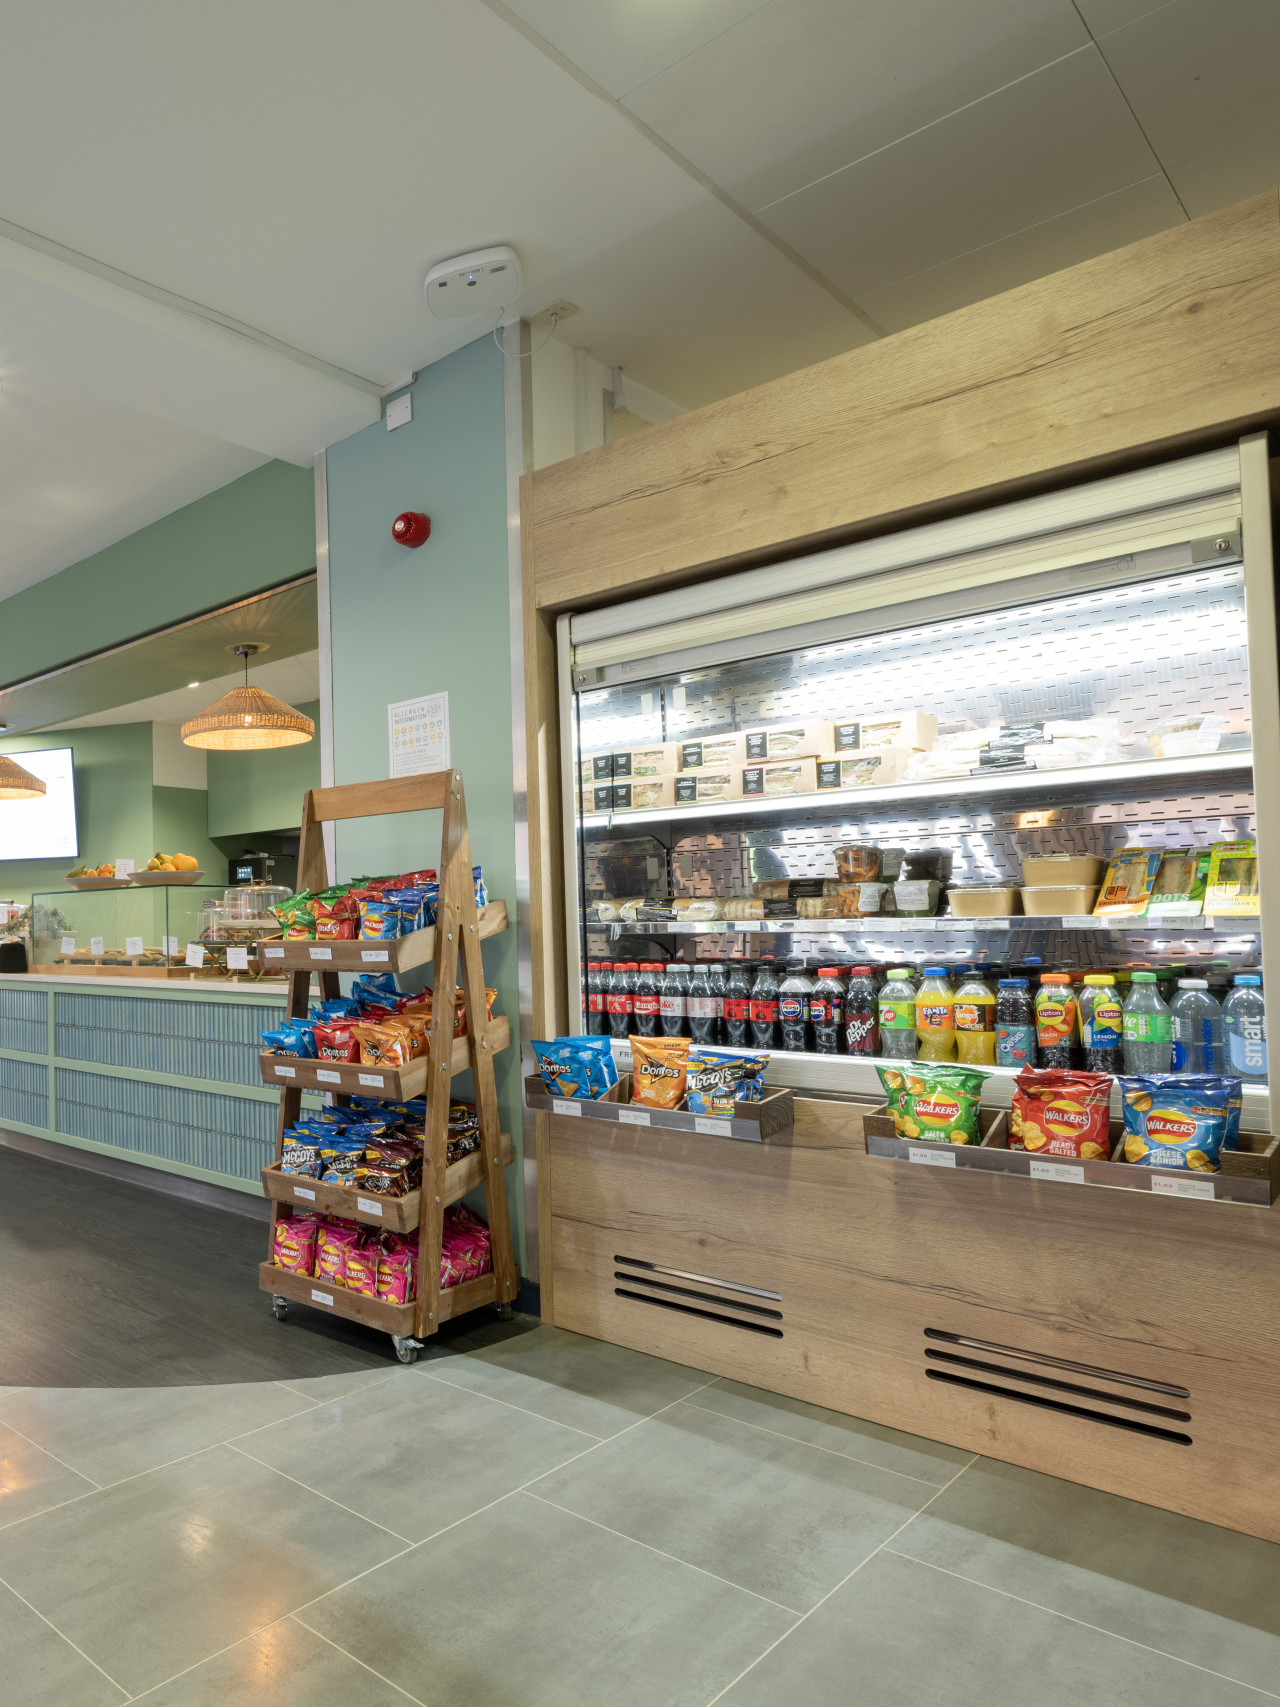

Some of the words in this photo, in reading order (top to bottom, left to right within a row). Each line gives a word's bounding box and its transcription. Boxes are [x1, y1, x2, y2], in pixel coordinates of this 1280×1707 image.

[923, 1007, 948, 1016] FANTA
[846, 1016, 876, 1046] Pepper
[850, 1018, 862, 1033] Dr
[1000, 1031, 1025, 1053] Oasis
[1242, 1015, 1263, 1067] smart
[322, 1047, 349, 1057] Doritos
[539, 1062, 572, 1073] Doritos
[641, 1064, 680, 1078] Doritos
[916, 1101, 959, 1115] WALKERS
[1045, 1109, 1090, 1127] WALKERS
[1146, 1118, 1195, 1134] WALKERS
[1051, 1140, 1076, 1149] READY
[1049, 1147, 1077, 1157] SALTED
[1151, 1150, 1182, 1158] CHEESE
[1157, 1156, 1184, 1166] ONION
[377, 1274, 395, 1282] ALKERS
